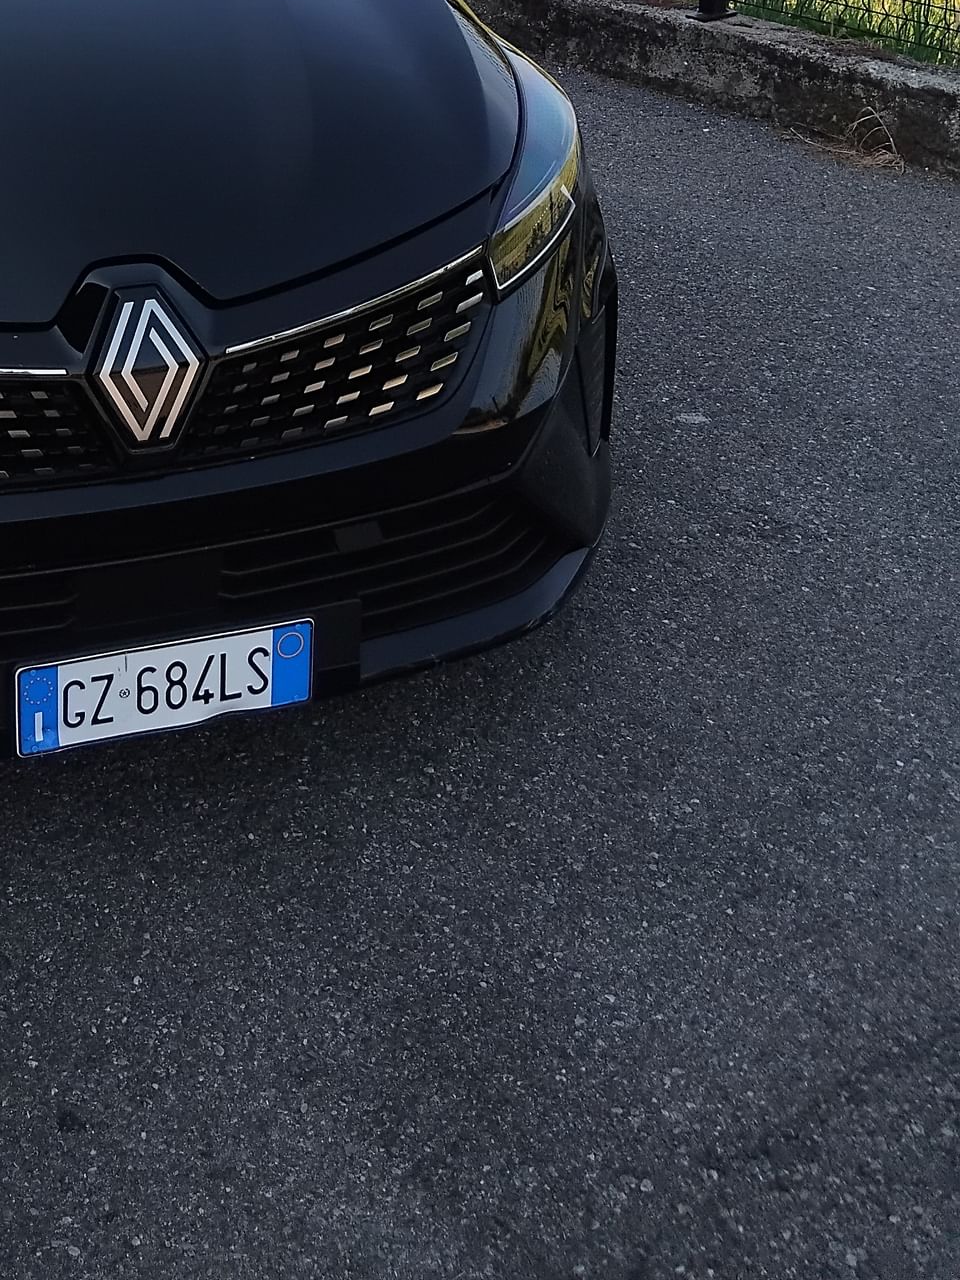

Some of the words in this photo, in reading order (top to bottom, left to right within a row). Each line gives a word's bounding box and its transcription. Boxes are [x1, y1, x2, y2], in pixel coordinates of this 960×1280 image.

[62, 674, 114, 728] GZ
[136, 647, 270, 714] 684LS
[34, 711, 44, 742] I
